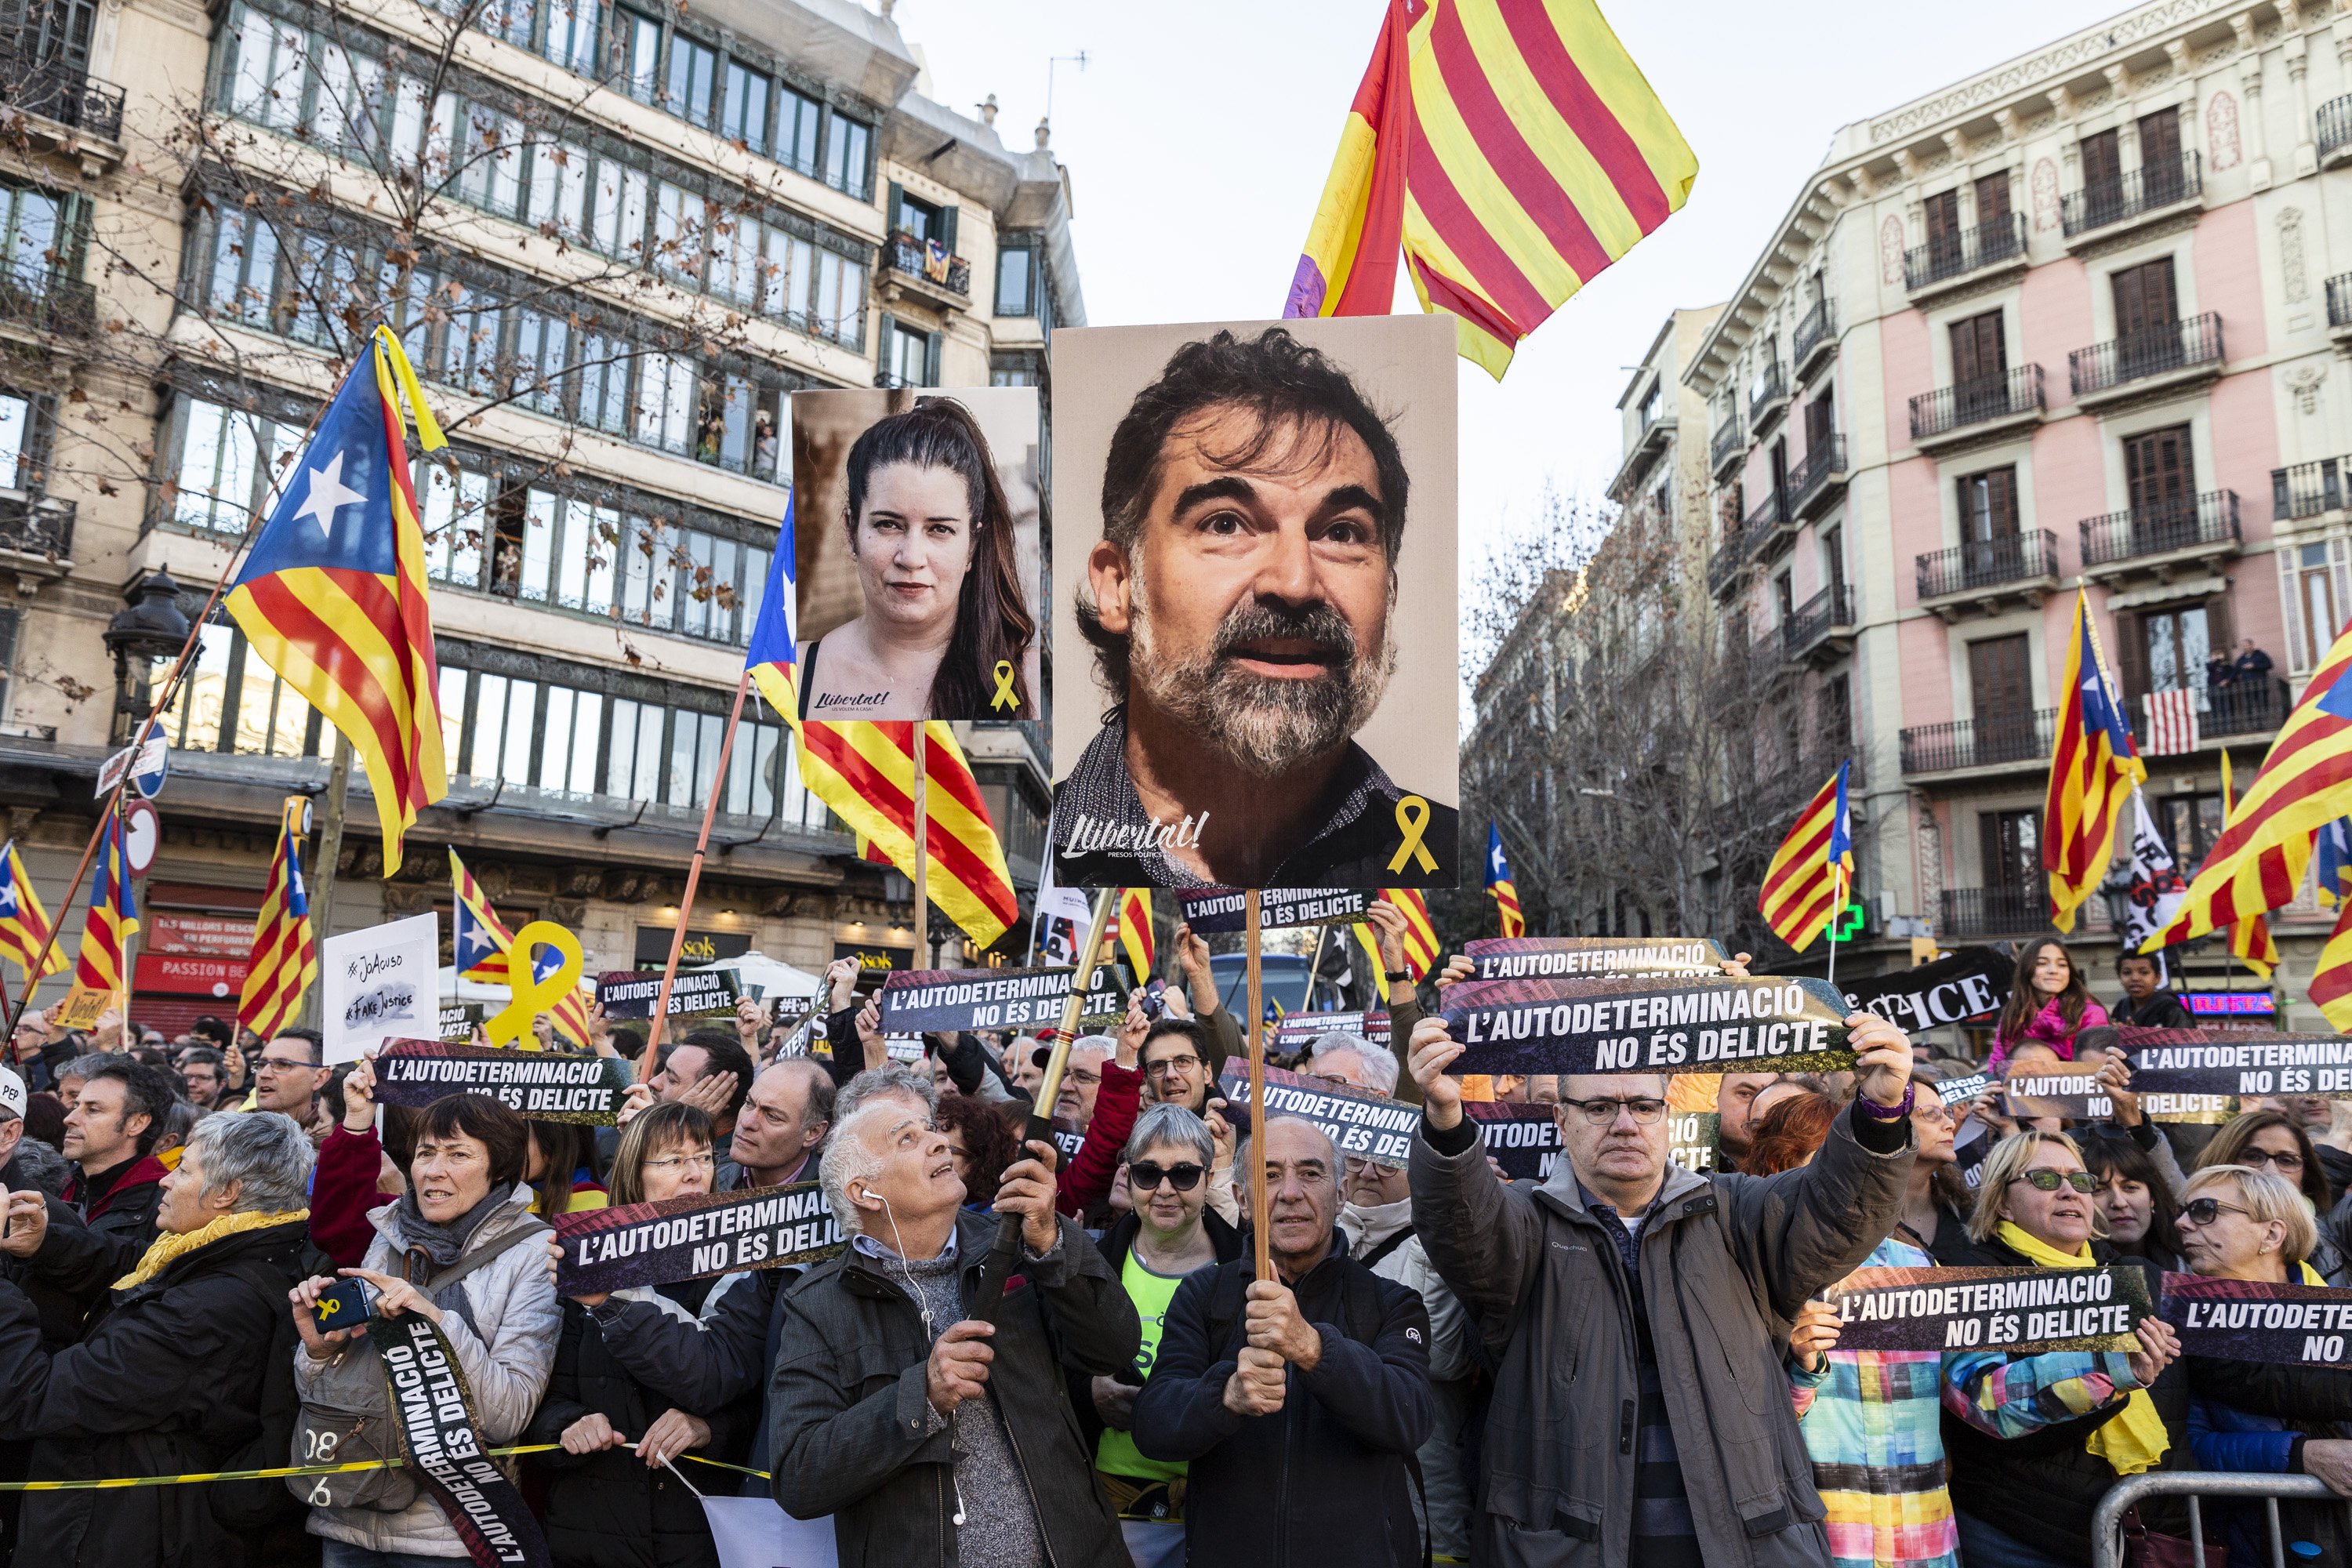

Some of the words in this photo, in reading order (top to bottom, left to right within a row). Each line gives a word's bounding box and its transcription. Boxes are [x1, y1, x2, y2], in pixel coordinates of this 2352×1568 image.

[814, 691, 890, 709] Llibertat!
[1061, 811, 1210, 859] Llibertat!
[1259, 909, 1272, 927] O
[1275, 905, 1295, 924] ÉS
[1298, 894, 1363, 921] DELICTE
[162, 961, 227, 977] PASSION
[227, 964, 248, 978] BE
[1482, 941, 1706, 978] L'AUTODETERMINACIÓ
[604, 971, 720, 1003] L'AUTODETMINACIÓ
[891, 967, 1104, 1011] L'AUTODETERMINAÓ
[667, 995, 681, 1014] ÉS
[684, 990, 731, 1013] DELICTE
[971, 1005, 1001, 1027] NO
[1005, 1000, 1031, 1024] ÉS
[1466, 980, 1805, 1044] L'AUTODETERMINACIÓ
[1283, 1013, 1364, 1029] L'AUTODETERMINAC
[1595, 1037, 1640, 1071] NO
[1648, 1029, 1688, 1066] ÉS
[1697, 1019, 1829, 1062] DELICTE
[2141, 1044, 2352, 1070] L'AUTODETERMINA
[387, 1058, 603, 1084] L'AUTODETERMINACIÓ
[2239, 1071, 2273, 1094] NO
[2280, 1067, 2311, 1092] ÉS
[2, 1085, 19, 1102] PEP
[527, 1088, 613, 1111] DELICTE
[2087, 1097, 2114, 1117] NO
[2146, 1095, 2223, 1115] DELICTE
[1341, 1124, 1374, 1152] ÉS
[579, 1191, 833, 1267] L'AUTODETERMINAC
[692, 1242, 729, 1275] NO
[736, 1229, 769, 1265] ÉS
[776, 1218, 846, 1256] DELIC
[1840, 1269, 2112, 1323] L'AUTODETERMINACIÓ
[1944, 1320, 1983, 1348] NO
[1988, 1315, 2020, 1343] ÉS
[2027, 1305, 2130, 1340] DELICTE
[2187, 1302, 2352, 1330] L'AUTODETE
[2302, 1335, 2345, 1363] NO
[408, 1321, 467, 1423] DELICTE
[382, 1345, 525, 1562] L'AUTODETERMINACIÓ
[445, 1427, 481, 1461] ÉS
[463, 1461, 504, 1484] NO
